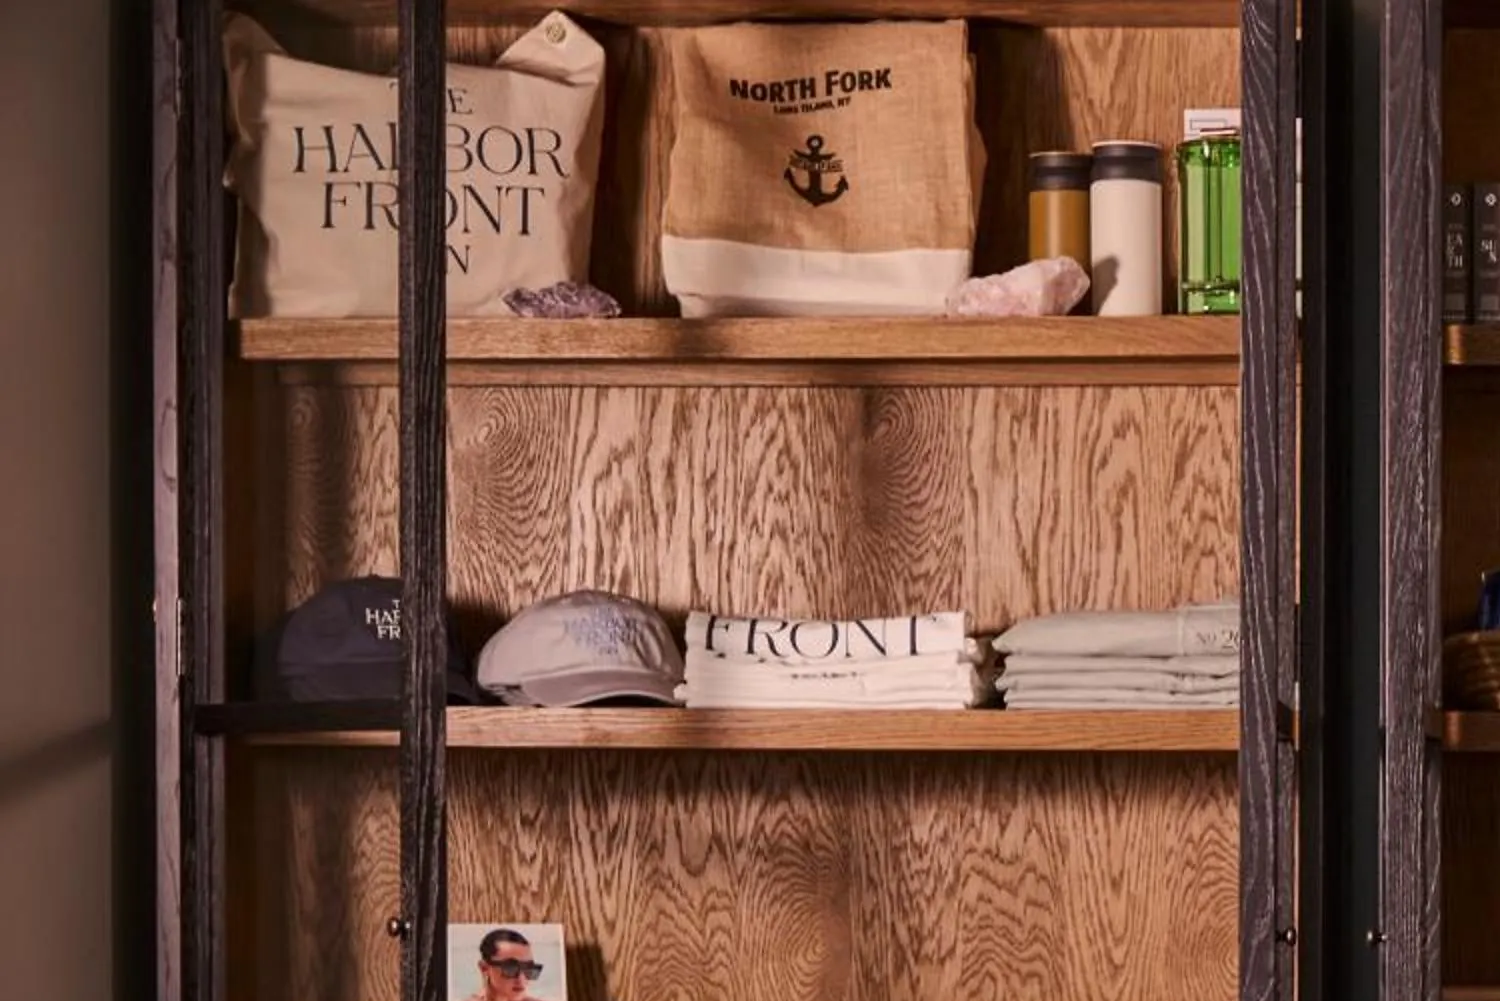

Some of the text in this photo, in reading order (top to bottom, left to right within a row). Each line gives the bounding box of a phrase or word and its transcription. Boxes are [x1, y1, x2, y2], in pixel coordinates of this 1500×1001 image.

[730, 68, 892, 103] NORTH FORK
[293, 123, 570, 178] HABOR
[321, 181, 546, 236] FRNT
